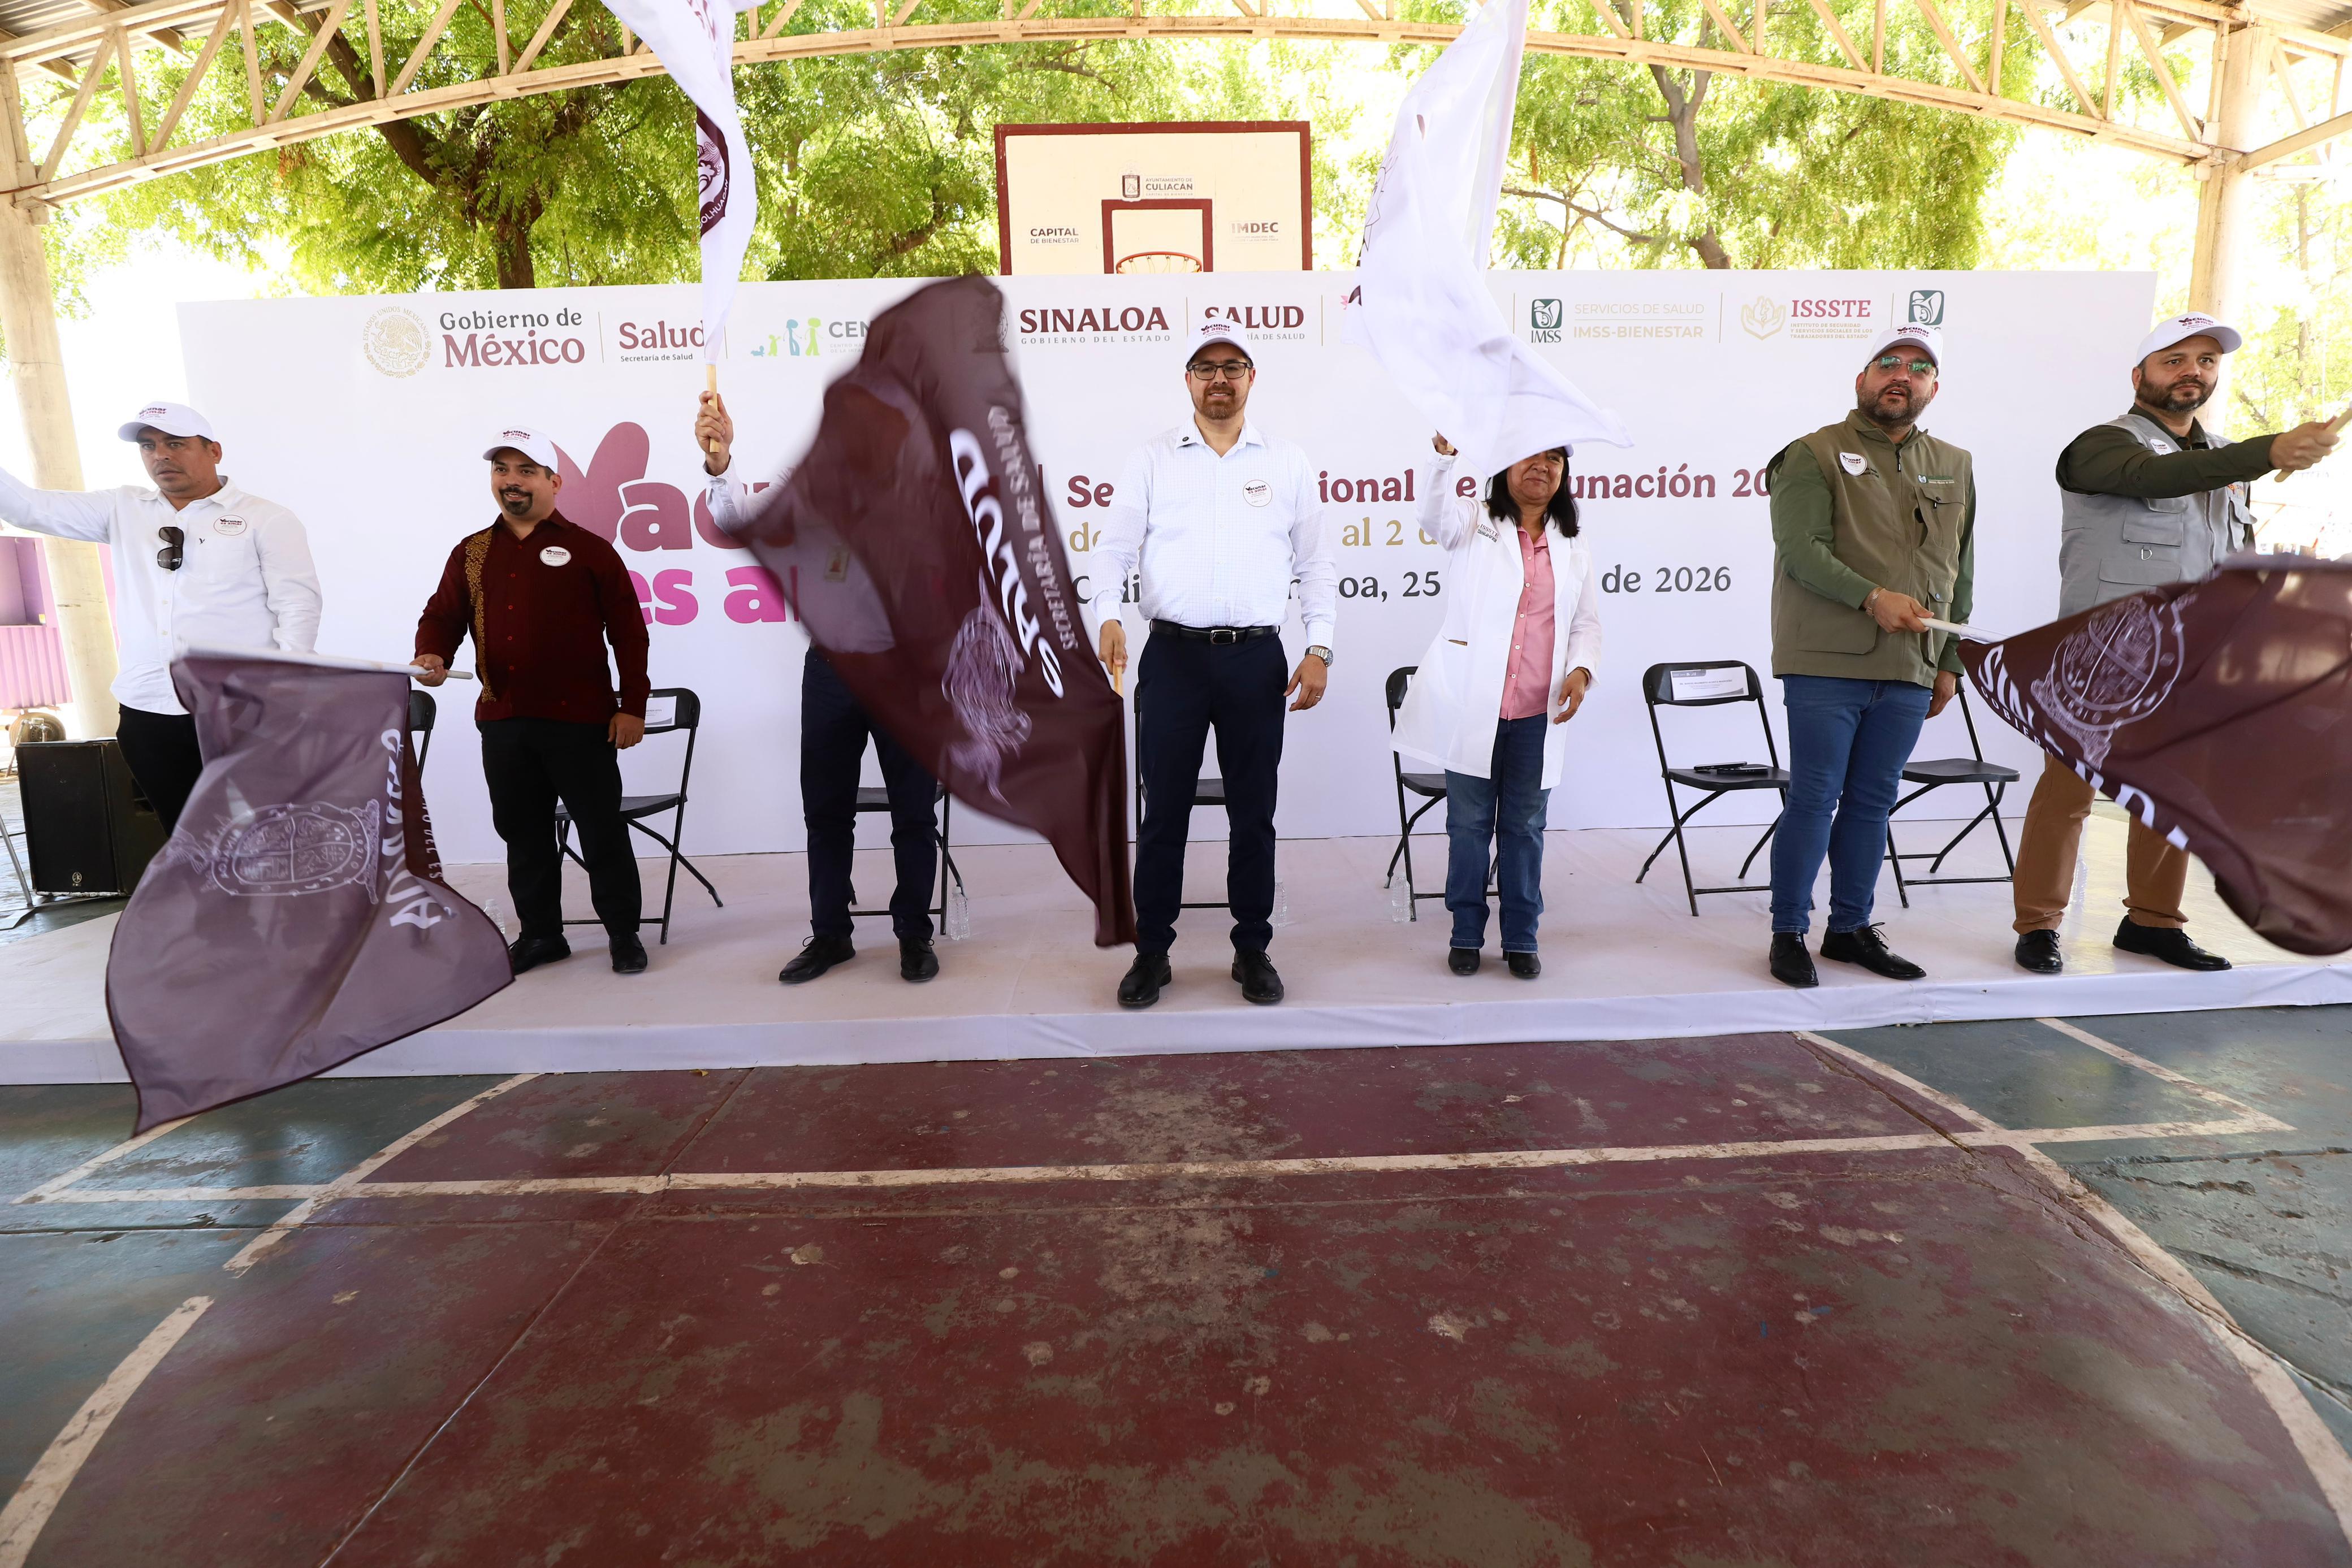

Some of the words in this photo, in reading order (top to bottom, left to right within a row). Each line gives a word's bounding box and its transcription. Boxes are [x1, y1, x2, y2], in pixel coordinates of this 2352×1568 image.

[1030, 228, 1079, 236] CAPITAL
[1231, 222, 1279, 233] IMDEC
[440, 310, 550, 331] Gobierno
[556, 307, 582, 326] de
[1020, 307, 1170, 333] SINALOA
[1575, 304, 1640, 314] SERVICIOS
[1643, 304, 1660, 314] DE
[1663, 304, 1705, 314] SALUD
[1791, 299, 1871, 318] ISSSTE
[362, 314, 377, 341] ESTADOS
[377, 306, 401, 316] UNIDOS
[403, 308, 430, 339] MEXICANOS
[619, 319, 704, 349] Salud
[1573, 326, 1704, 338] IMSS-BIENESTAR
[442, 330, 585, 367] México
[1531, 330, 1562, 344] IMSS
[1342, 517, 1372, 546] al
[1385, 519, 1404, 545] 2
[1402, 571, 1441, 597] 25
[1601, 564, 1641, 594] de
[1655, 566, 1731, 593] 2026
